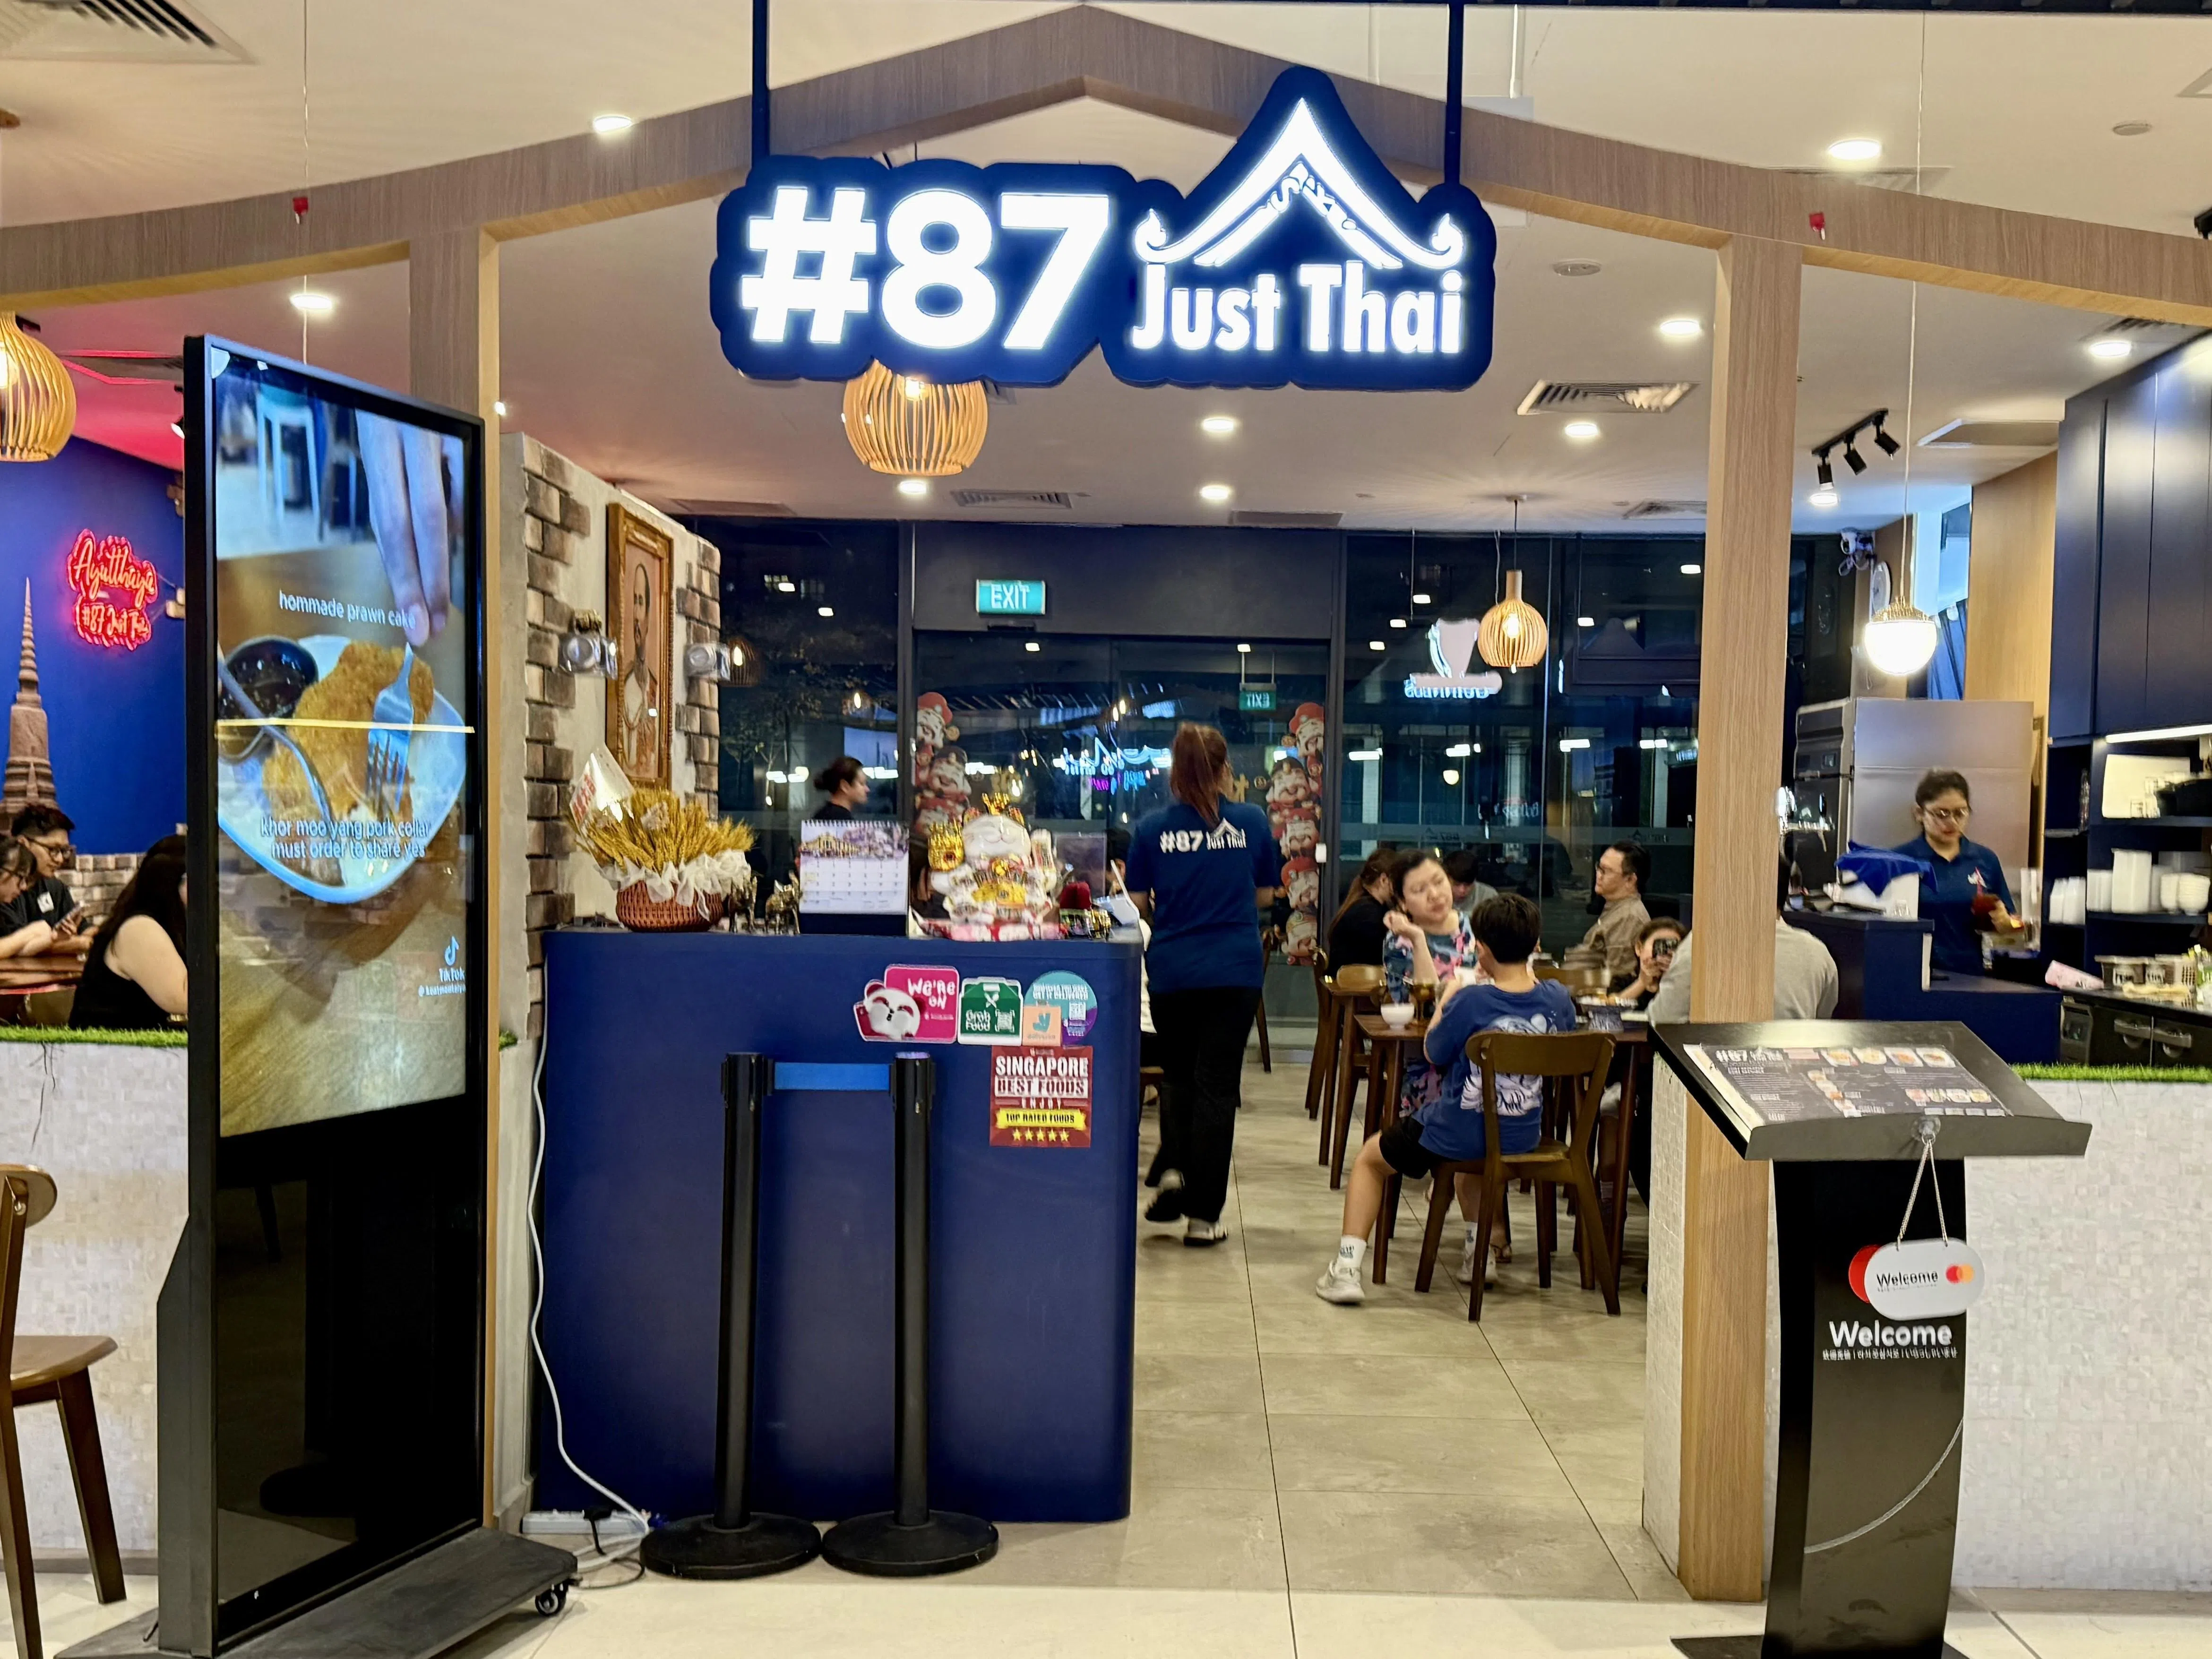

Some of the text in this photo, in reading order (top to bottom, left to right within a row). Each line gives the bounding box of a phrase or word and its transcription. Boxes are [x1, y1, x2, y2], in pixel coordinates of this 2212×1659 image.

[741, 185, 1110, 349] #87
[1131, 260, 1463, 355] Just Thai
[991, 584, 1030, 609] EXIT
[347, 604, 385, 625] prawn
[296, 819, 327, 837] moo
[330, 819, 363, 841] yang
[366, 818, 396, 839] pork
[272, 841, 306, 858] must
[310, 839, 345, 858] order
[350, 839, 364, 858] to
[367, 840, 401, 859] share
[996, 1055, 1088, 1077] SINGAPORE
[1038, 1078, 1085, 1096] FOODS
[1876, 1271, 1938, 1286] Welcome
[1829, 1319, 1953, 1347] Welcome
